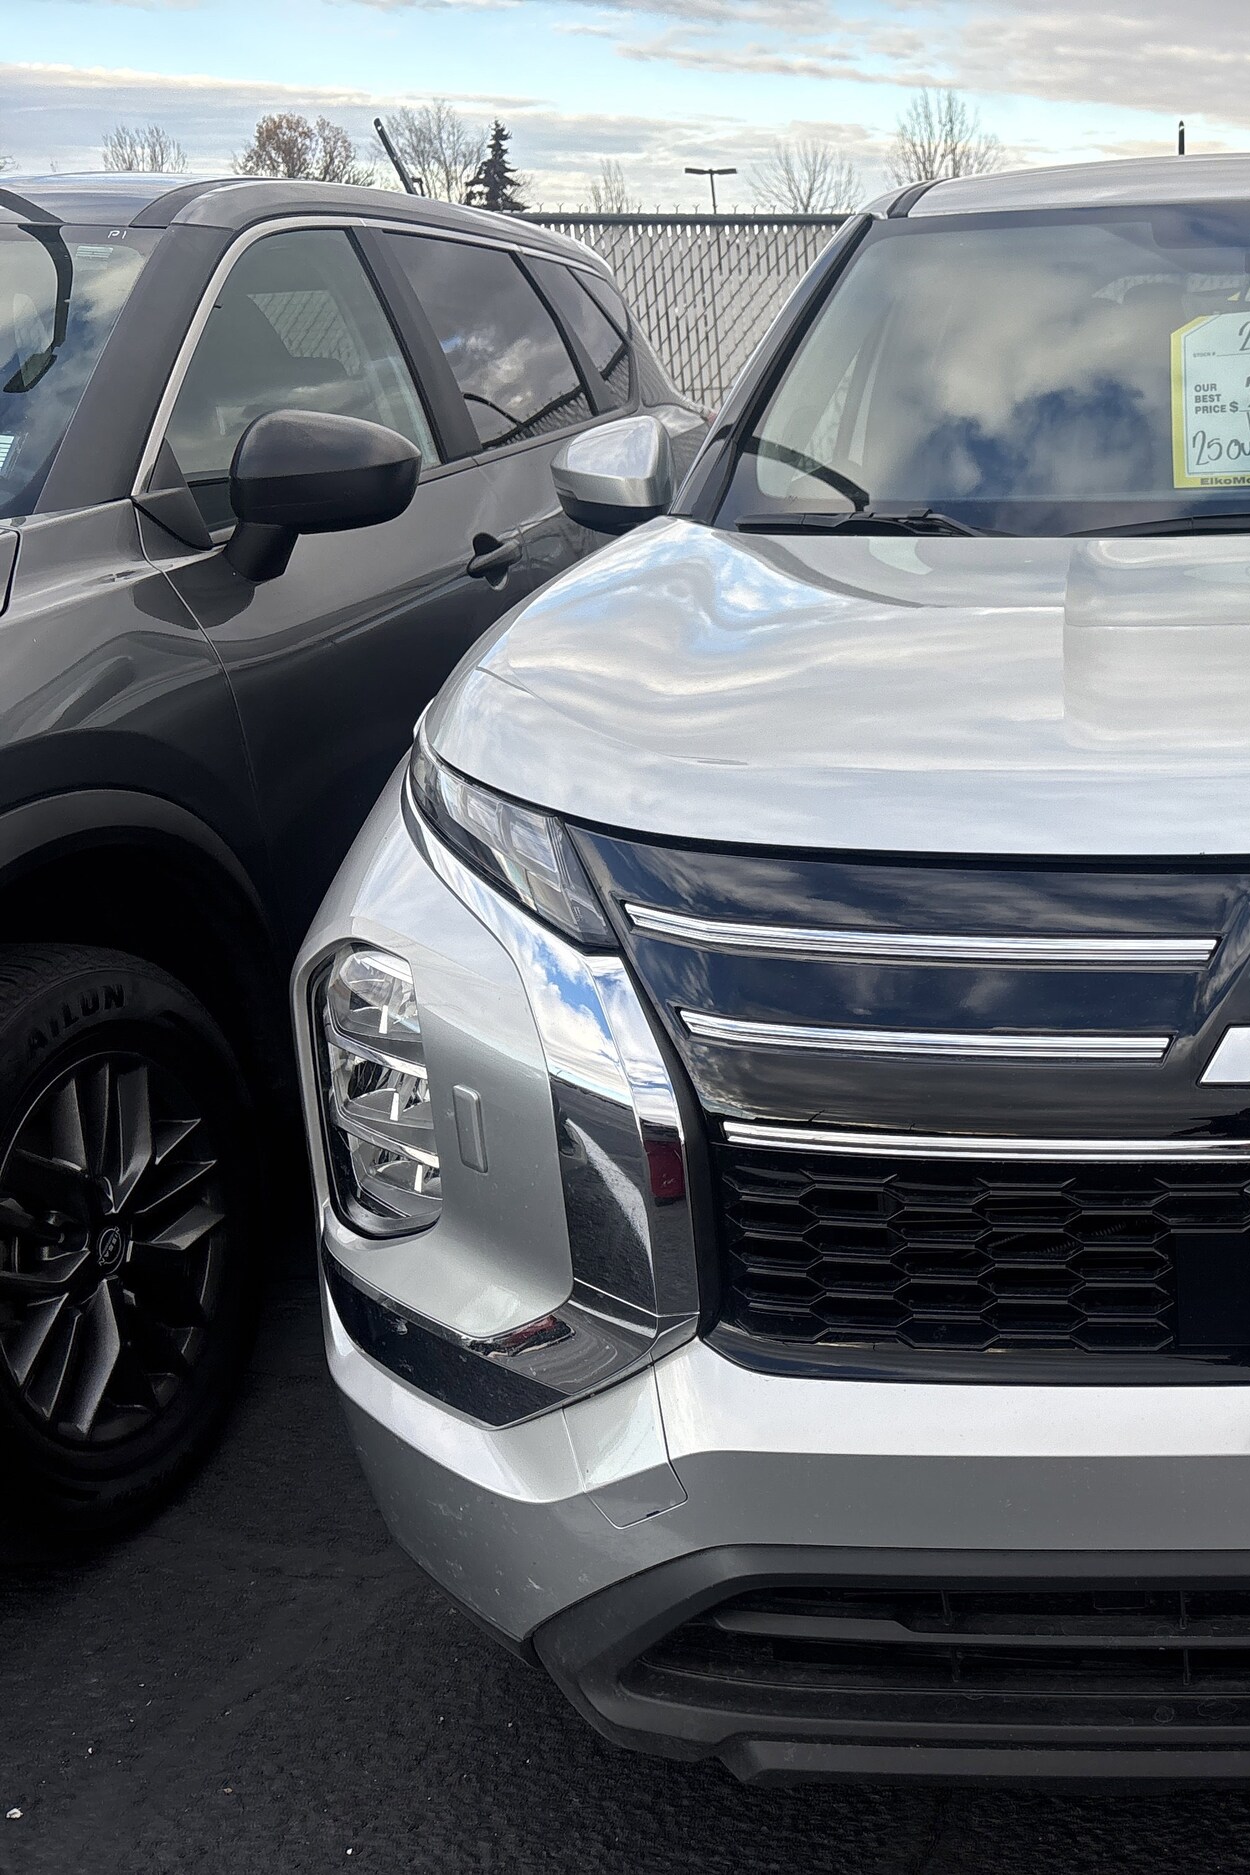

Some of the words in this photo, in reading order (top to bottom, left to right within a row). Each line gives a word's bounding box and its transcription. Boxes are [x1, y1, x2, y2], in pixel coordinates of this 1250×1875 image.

[1194, 383, 1218, 392] OUR
[1194, 393, 1222, 404] BEST
[1194, 404, 1227, 415] PRICE
[1229, 400, 1240, 414] $
[1192, 430, 1223, 466] 25
